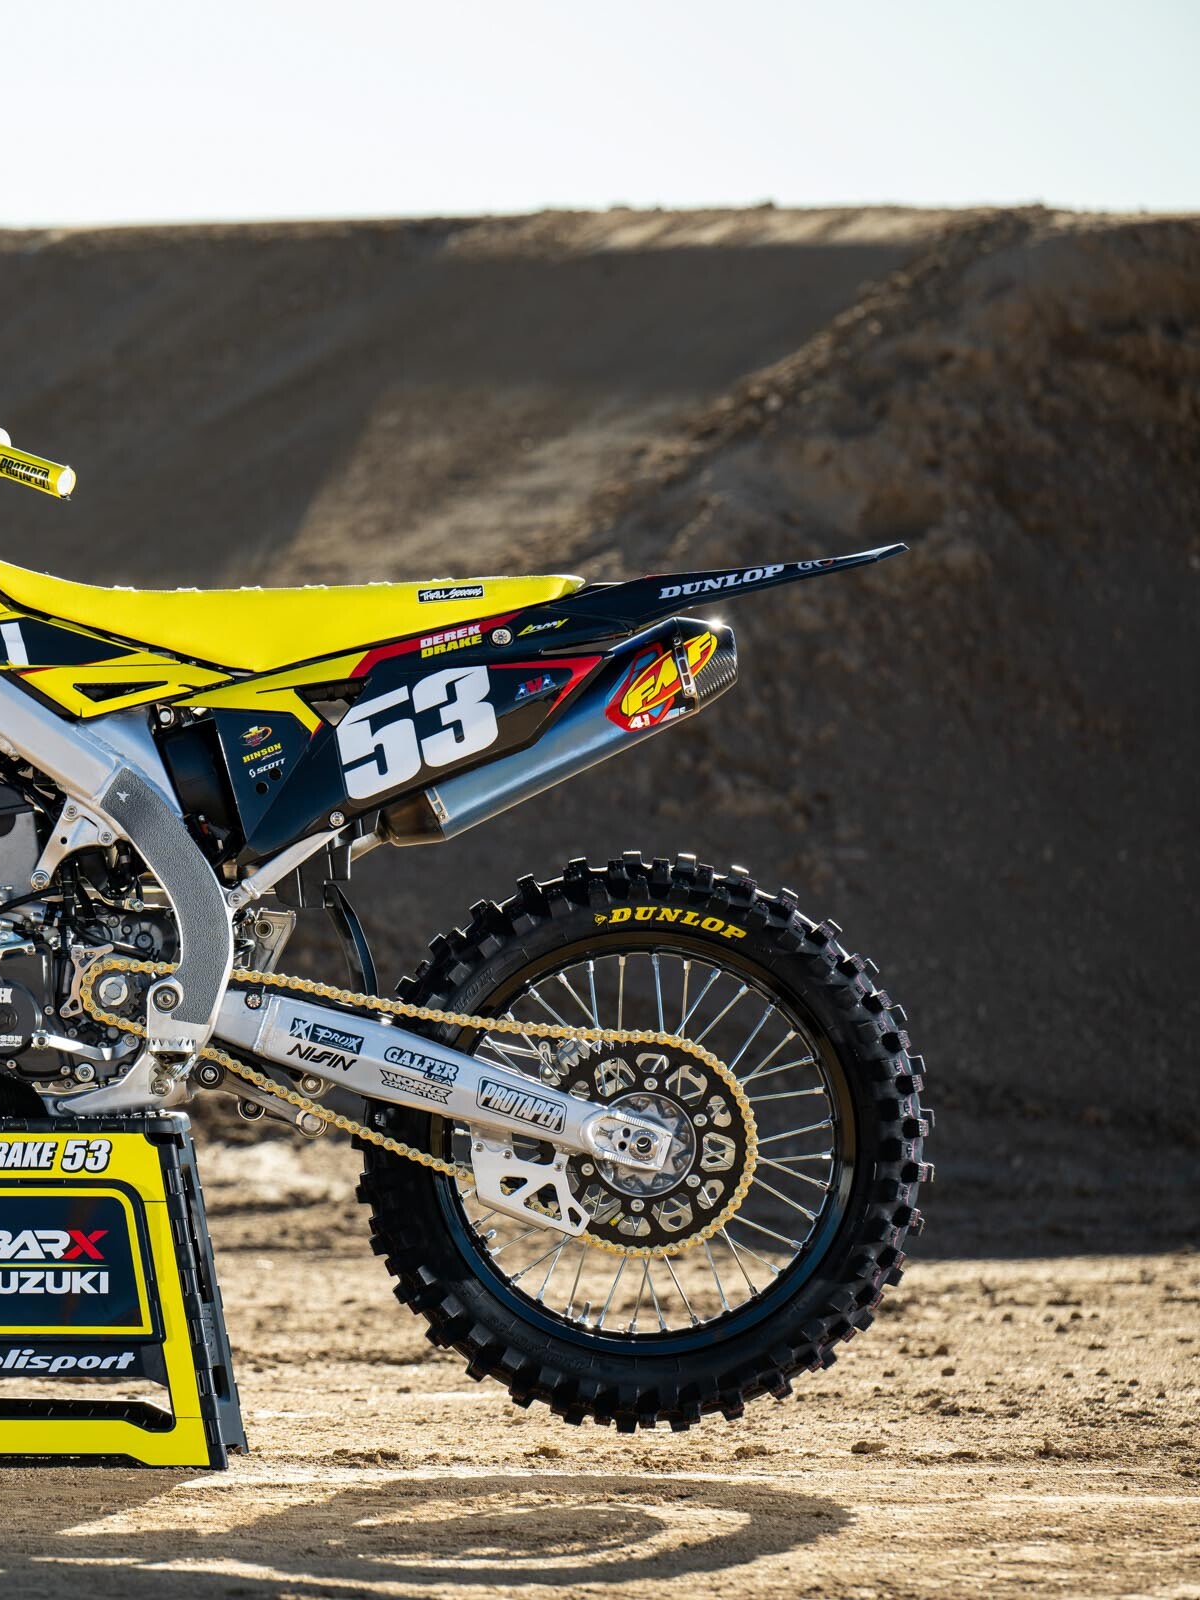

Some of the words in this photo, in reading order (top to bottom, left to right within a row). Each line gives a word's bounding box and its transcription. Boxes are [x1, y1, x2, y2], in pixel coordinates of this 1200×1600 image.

[0, 457, 49, 490] PROTAPER
[658, 563, 784, 600] DUNLOP
[420, 624, 481, 649] DEREK
[421, 634, 483, 658] DRAKE
[627, 631, 713, 717] FMF
[337, 665, 499, 800] 53
[242, 743, 282, 763] HINSON
[257, 758, 286, 774] SCOTT
[608, 906, 748, 939] DUNLOP
[384, 1046, 459, 1081] GALFER
[424, 1072, 453, 1087] USA
[379, 1069, 453, 1097] WORKS
[381, 1079, 448, 1105] CONNECTION
[480, 1081, 564, 1131] PROTAPER
[60, 1139, 112, 1172] 53
